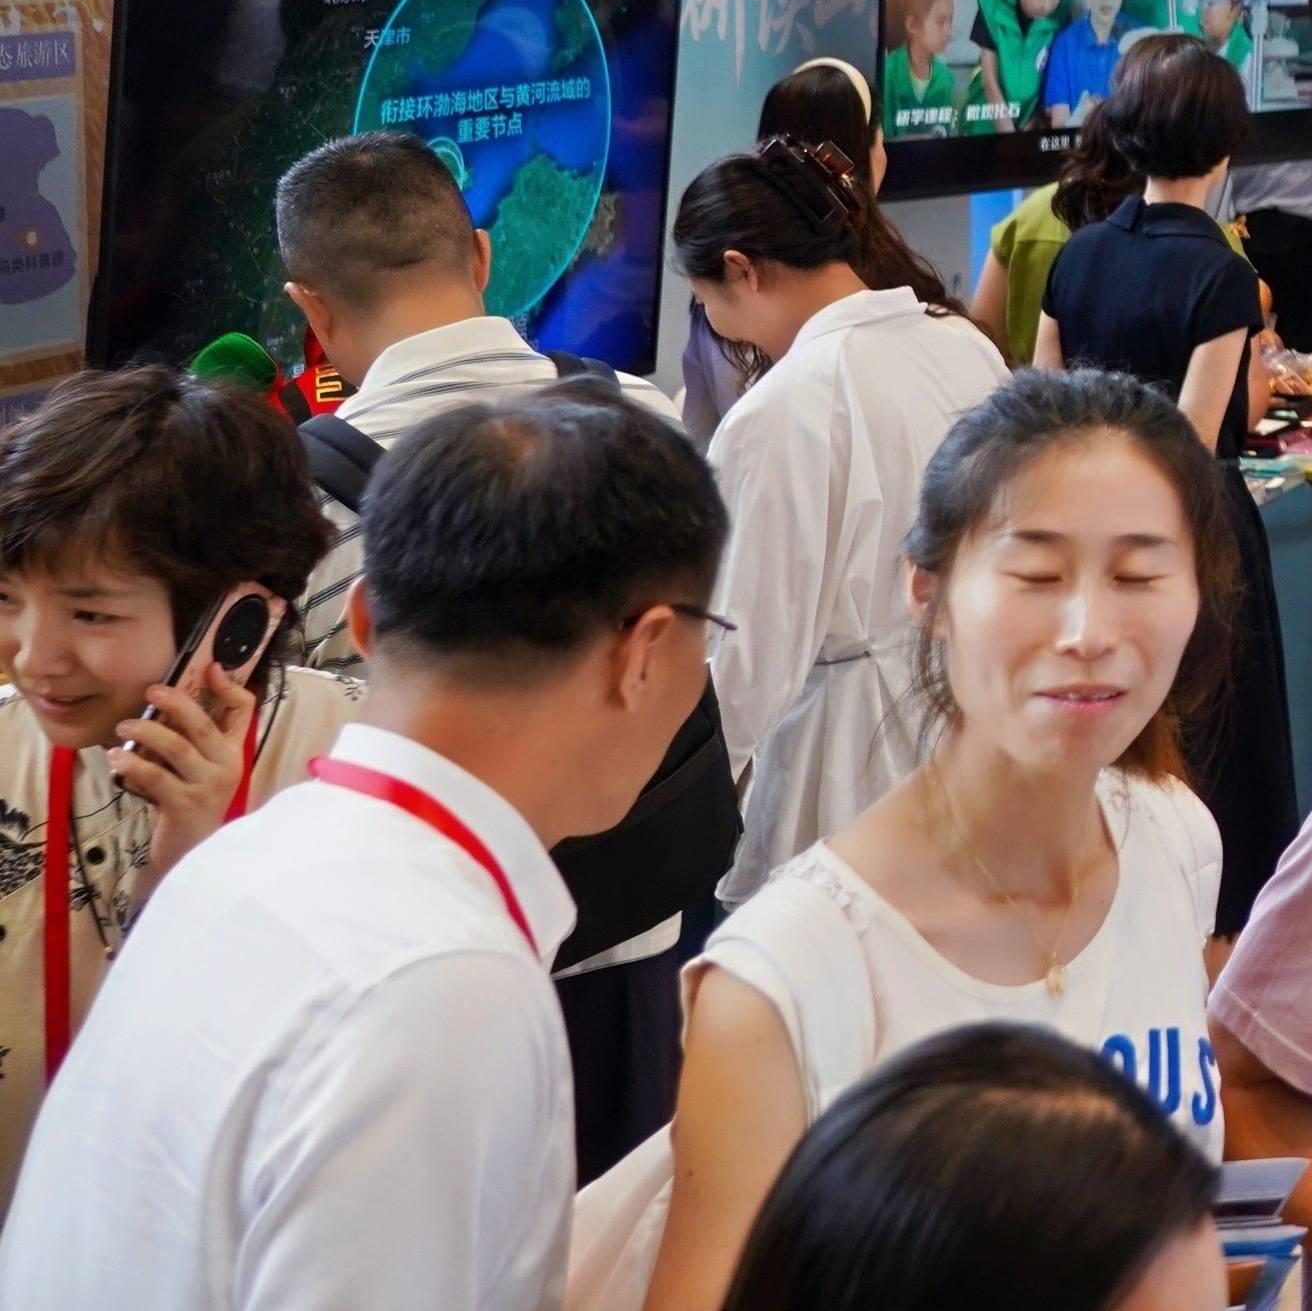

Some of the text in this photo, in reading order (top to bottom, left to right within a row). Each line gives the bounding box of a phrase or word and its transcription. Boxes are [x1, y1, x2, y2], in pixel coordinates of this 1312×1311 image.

[363, 27, 411, 48] 天津市
[381, 77, 591, 125] 衔接环渤海地区与黄河流域的
[457, 111, 523, 143] 重要节点
